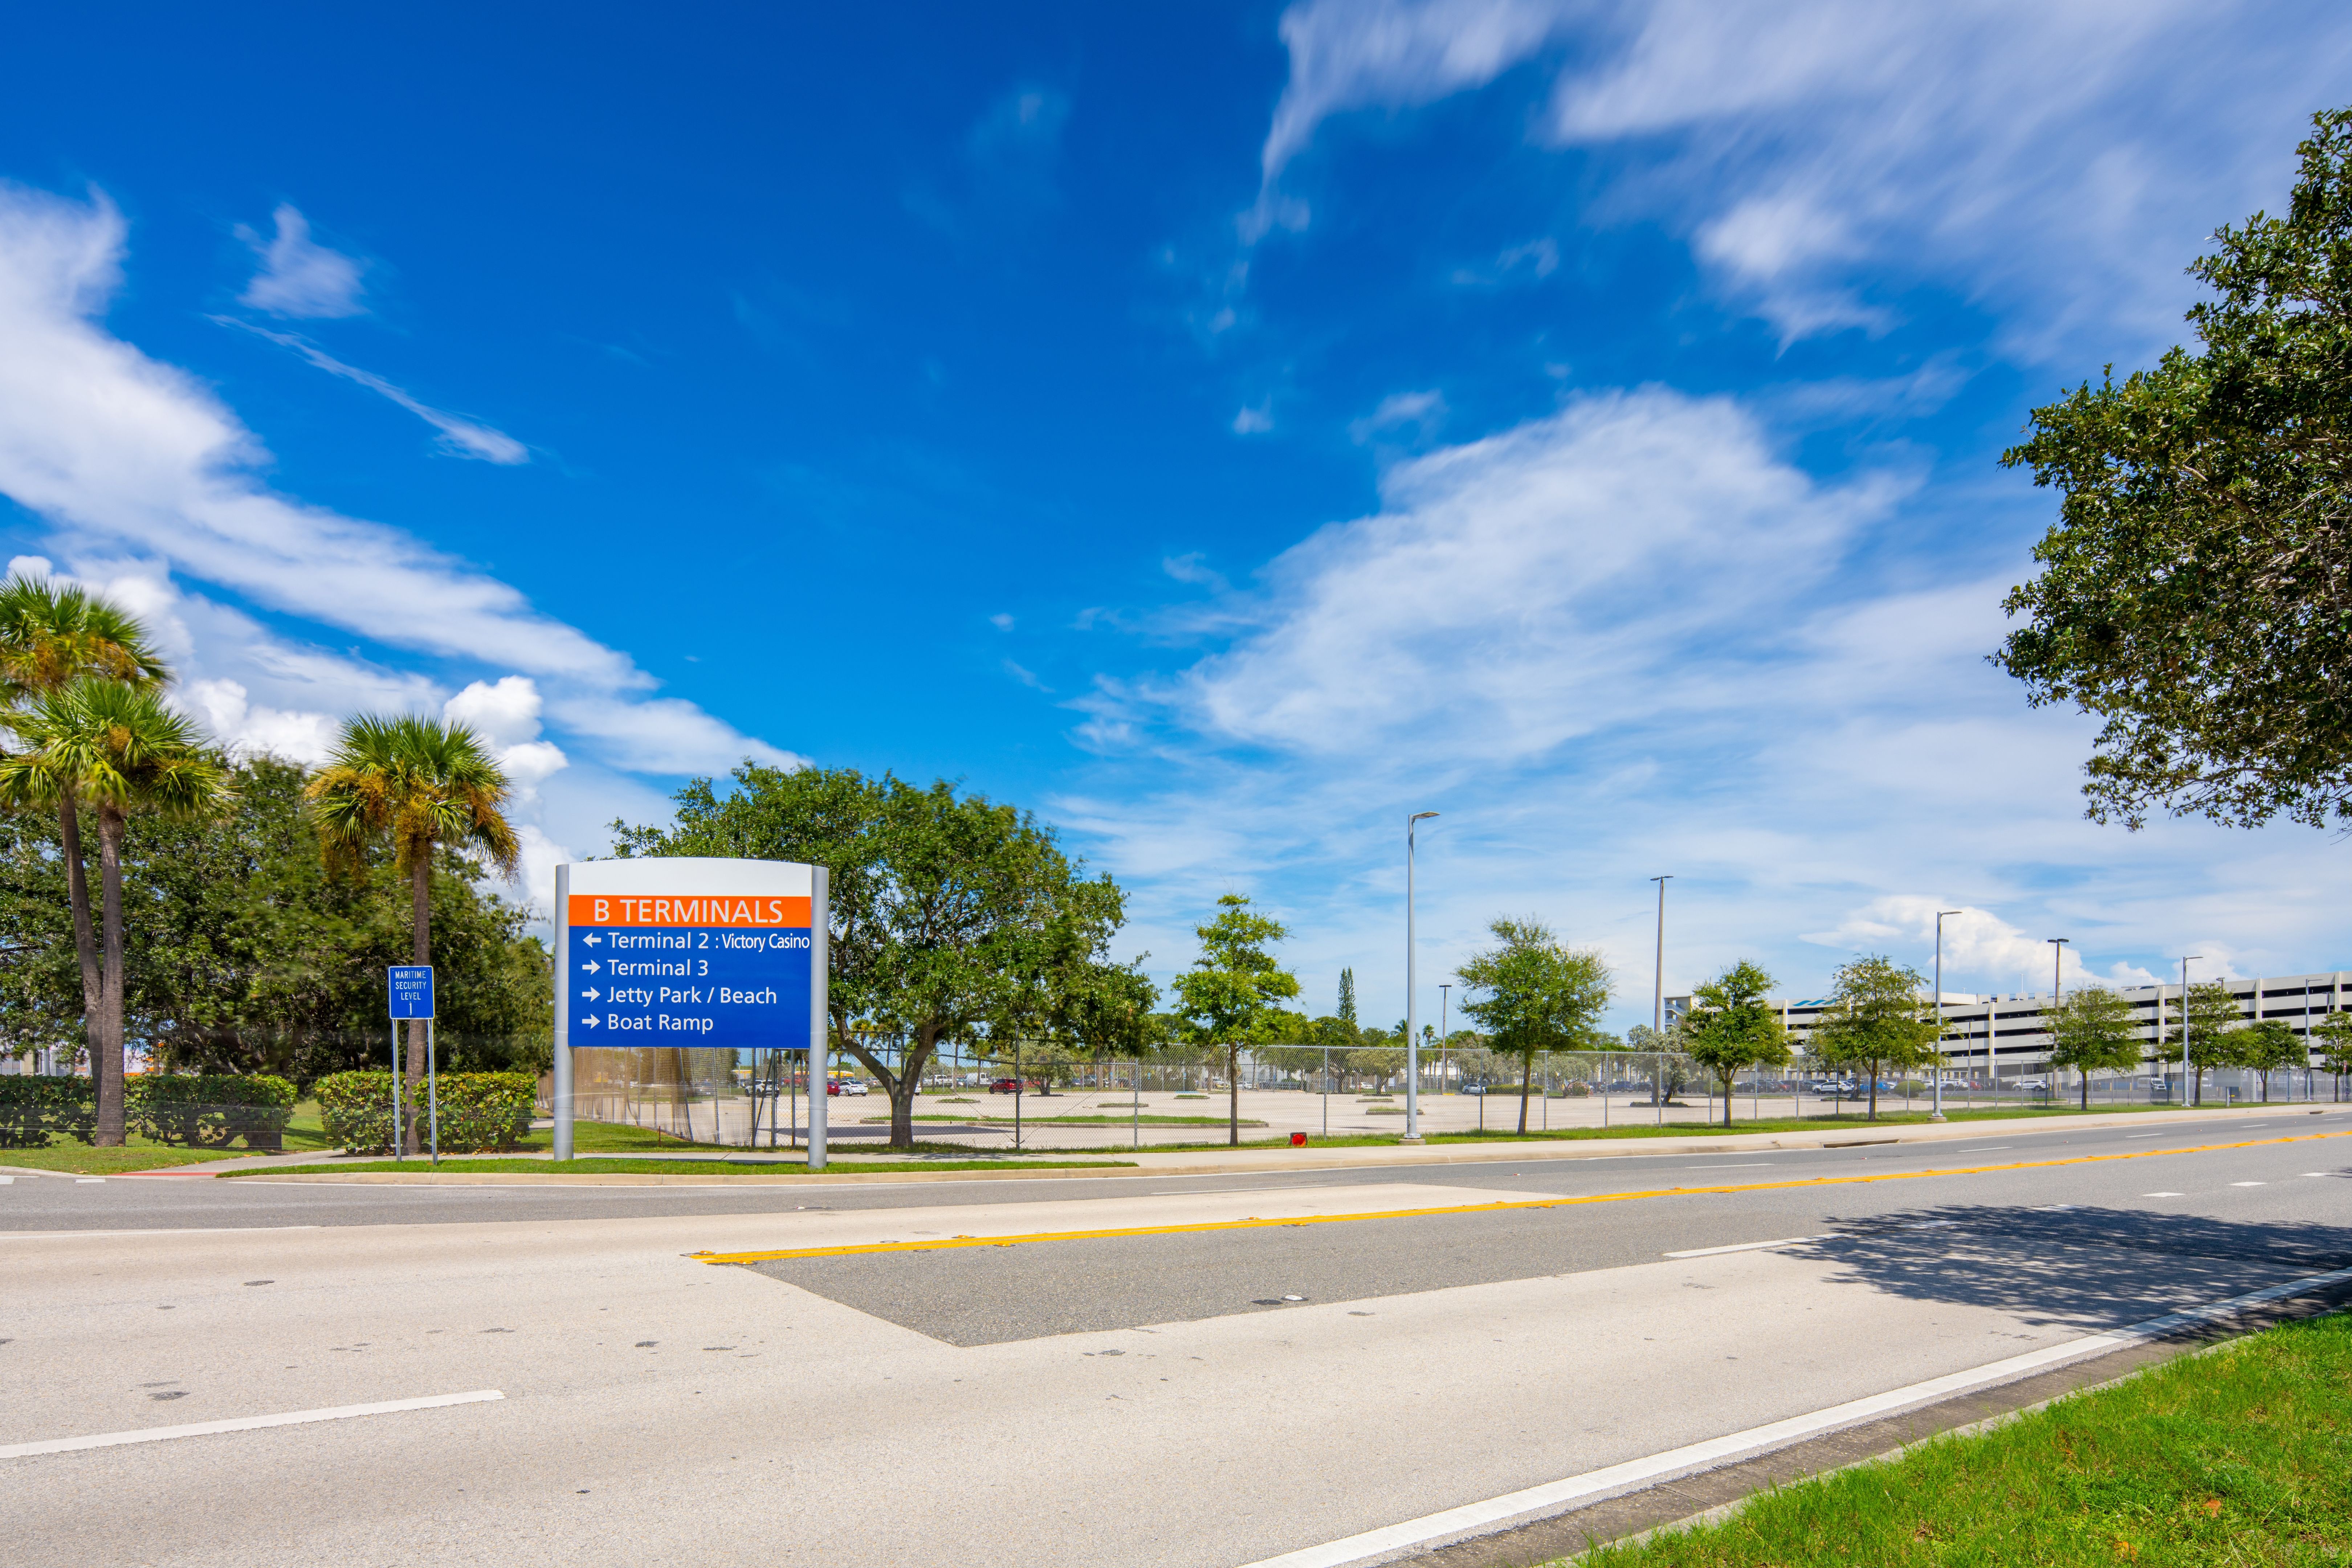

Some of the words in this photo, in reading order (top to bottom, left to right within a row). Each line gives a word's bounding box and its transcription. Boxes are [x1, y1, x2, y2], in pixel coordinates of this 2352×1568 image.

[595, 899, 609, 921] B
[620, 899, 782, 923] TERMINALS
[608, 932, 690, 948] Terminal
[698, 933, 708, 948] 2
[722, 934, 766, 952] Victory
[769, 933, 810, 948] Casino
[608, 959, 690, 976] Terminal
[698, 960, 708, 976] 3
[607, 987, 653, 1007] Jetty
[661, 986, 701, 1003] Park
[707, 987, 714, 1003] /
[721, 987, 776, 1004] Beach
[409, 1002, 412, 1016] 1
[609, 1014, 652, 1029] Boat
[660, 1014, 713, 1034] Ramp
